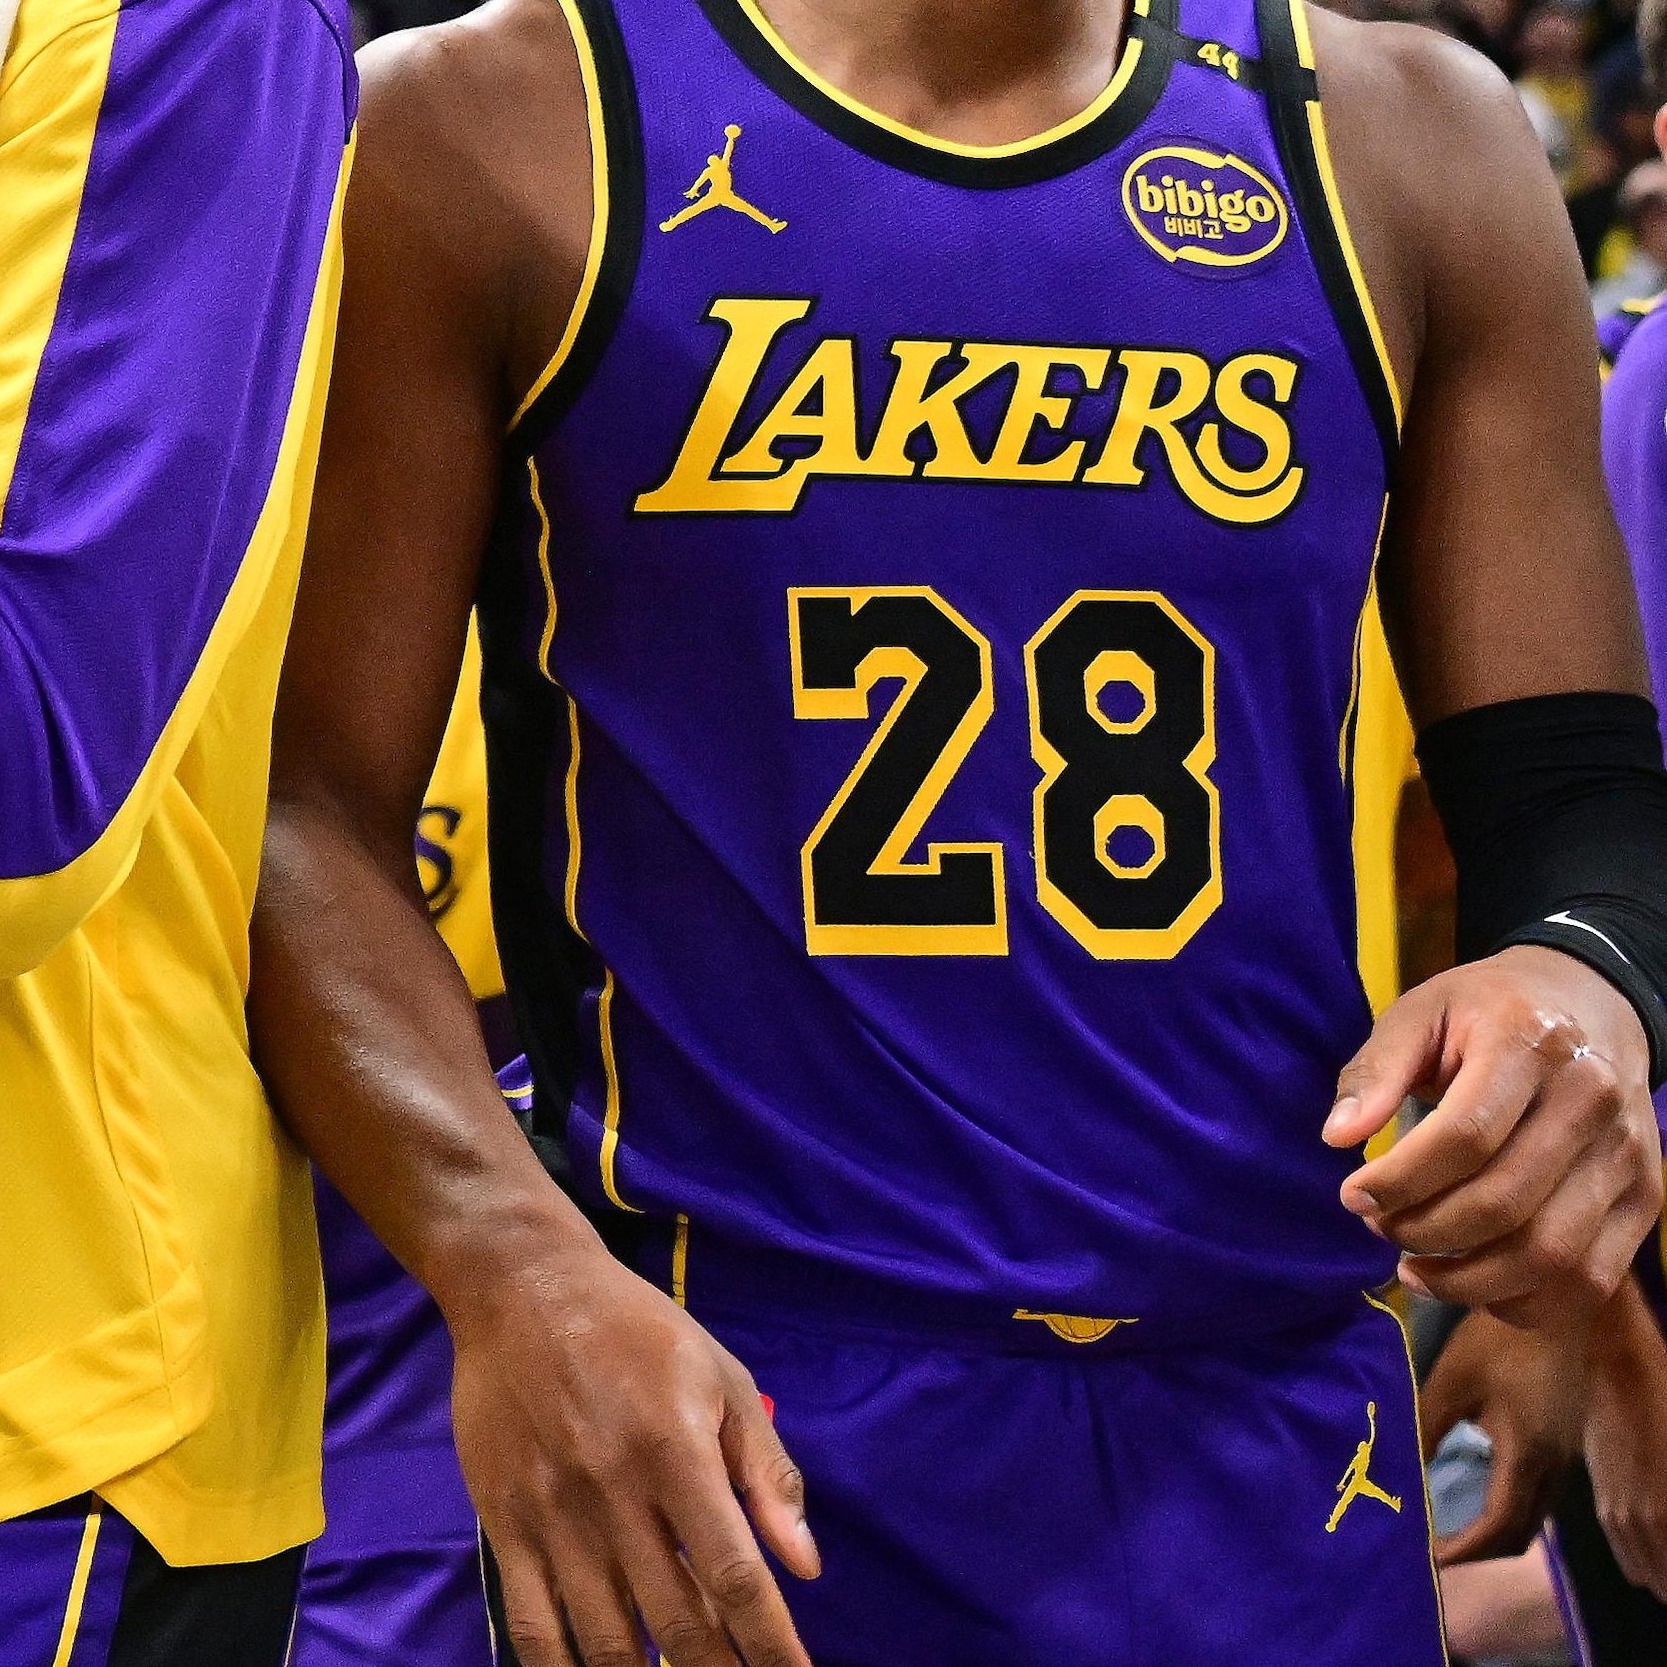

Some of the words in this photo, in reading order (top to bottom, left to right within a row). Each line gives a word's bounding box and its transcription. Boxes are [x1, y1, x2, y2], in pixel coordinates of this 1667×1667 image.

[1197, 43, 1241, 80] 44
[1135, 175, 1278, 233] bibigo
[1164, 216, 1225, 240] 비비고
[630, 296, 1305, 526] LAKERS
[787, 585, 1224, 960] 28
